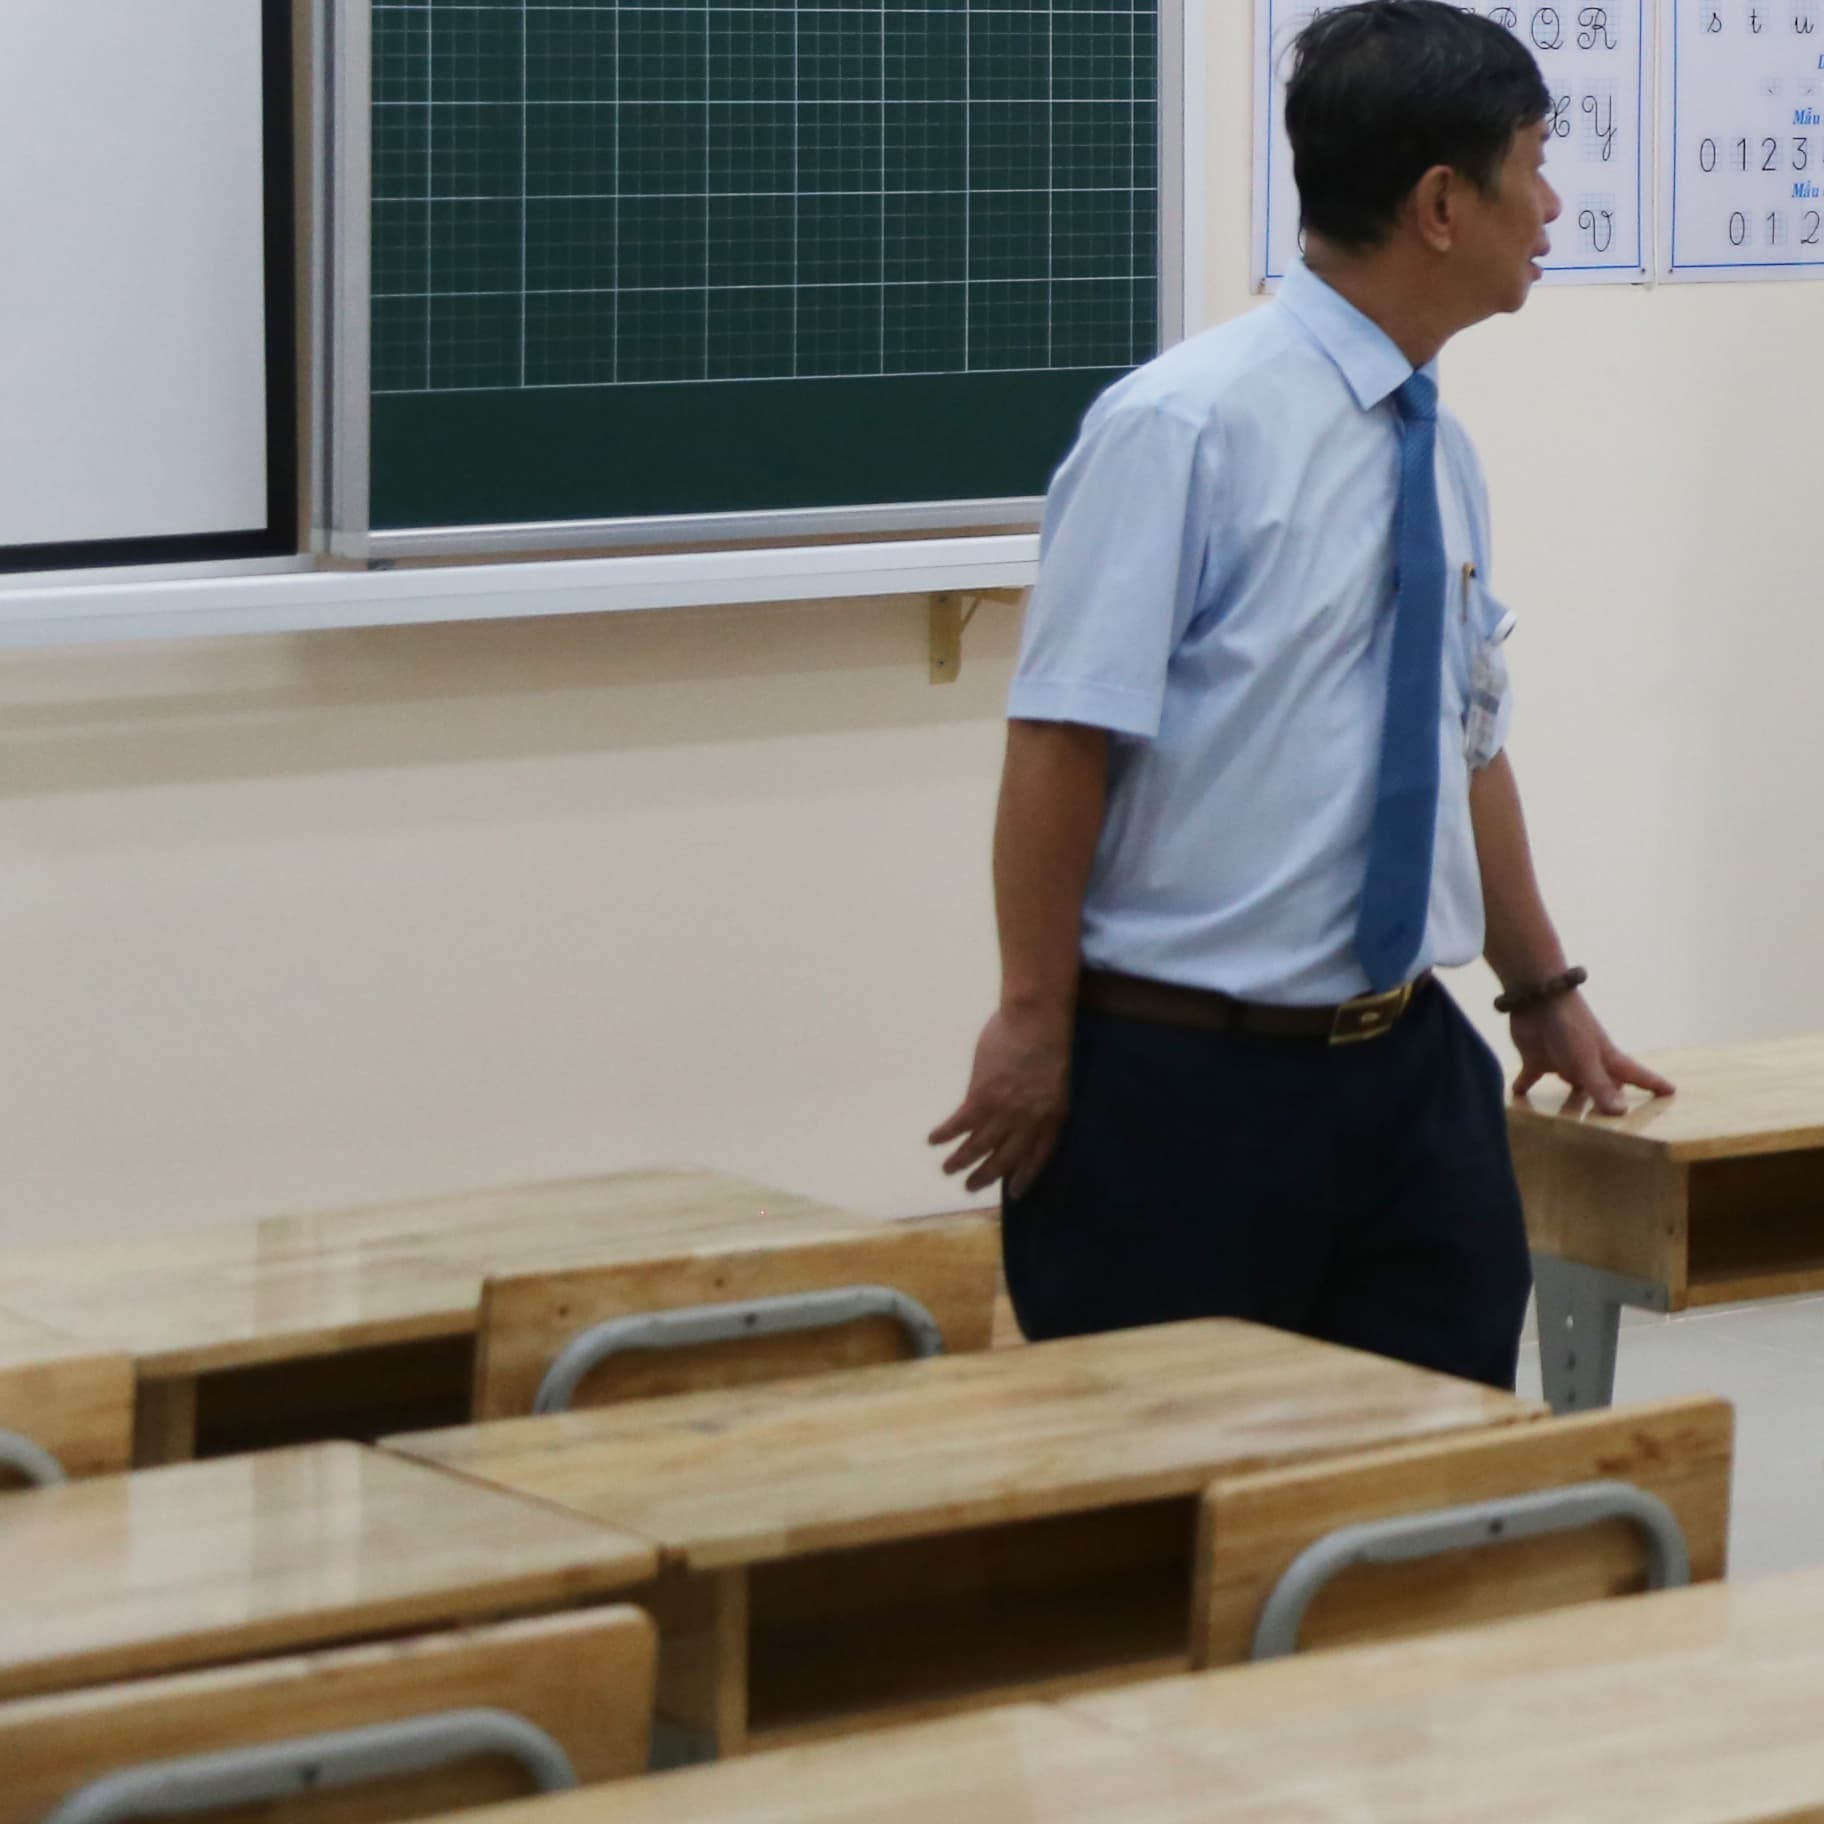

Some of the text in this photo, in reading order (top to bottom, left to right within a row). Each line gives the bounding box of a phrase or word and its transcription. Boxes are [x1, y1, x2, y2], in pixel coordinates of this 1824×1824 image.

[1531, 7, 1565, 50] Q
[1577, 7, 1617, 50] R
[1581, 94, 1618, 161] Y
[1699, 138, 1717, 173] 0
[1736, 138, 1747, 172] 1
[1761, 137, 1777, 172] 2
[1791, 137, 1808, 171] 3
[1728, 211, 1746, 246] 0
[1766, 211, 1776, 245] 1
[1800, 210, 1821, 245] 2
